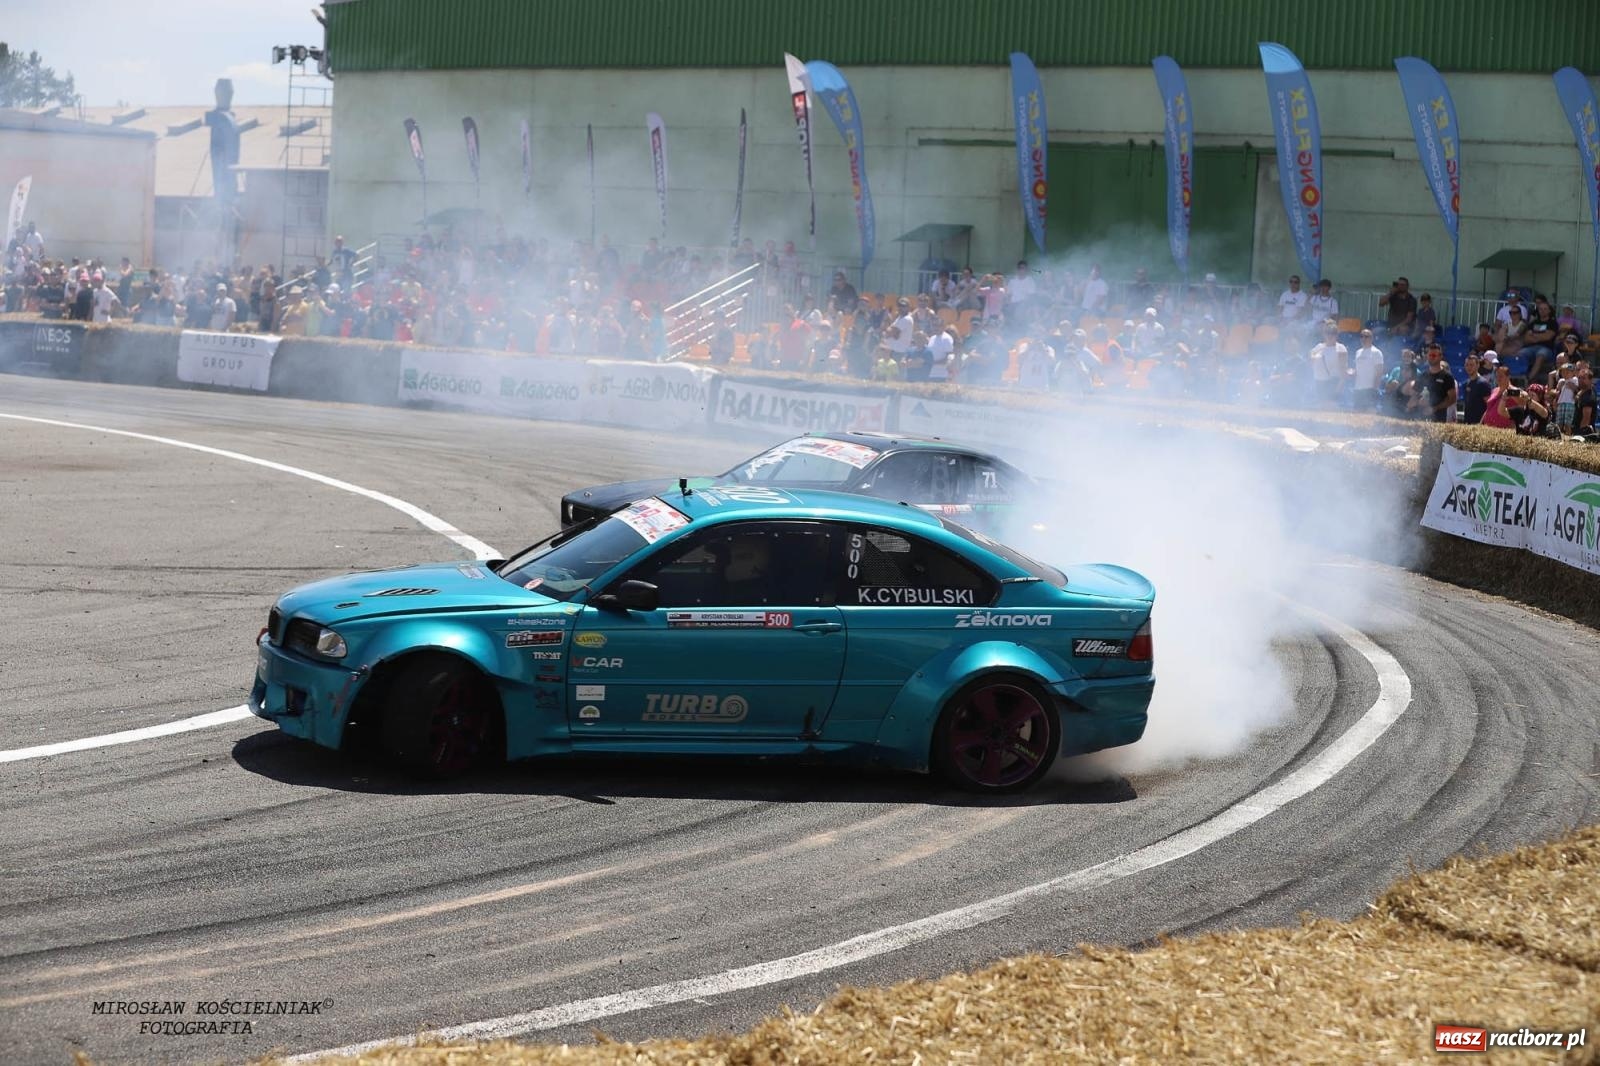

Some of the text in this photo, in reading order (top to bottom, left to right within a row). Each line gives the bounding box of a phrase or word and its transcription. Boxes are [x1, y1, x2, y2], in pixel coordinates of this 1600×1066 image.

[202, 357, 244, 370] GROUP
[982, 471, 998, 488] 71
[847, 533, 862, 580] 500
[857, 587, 974, 605] K.CYBULSKI
[767, 613, 790, 626] 500
